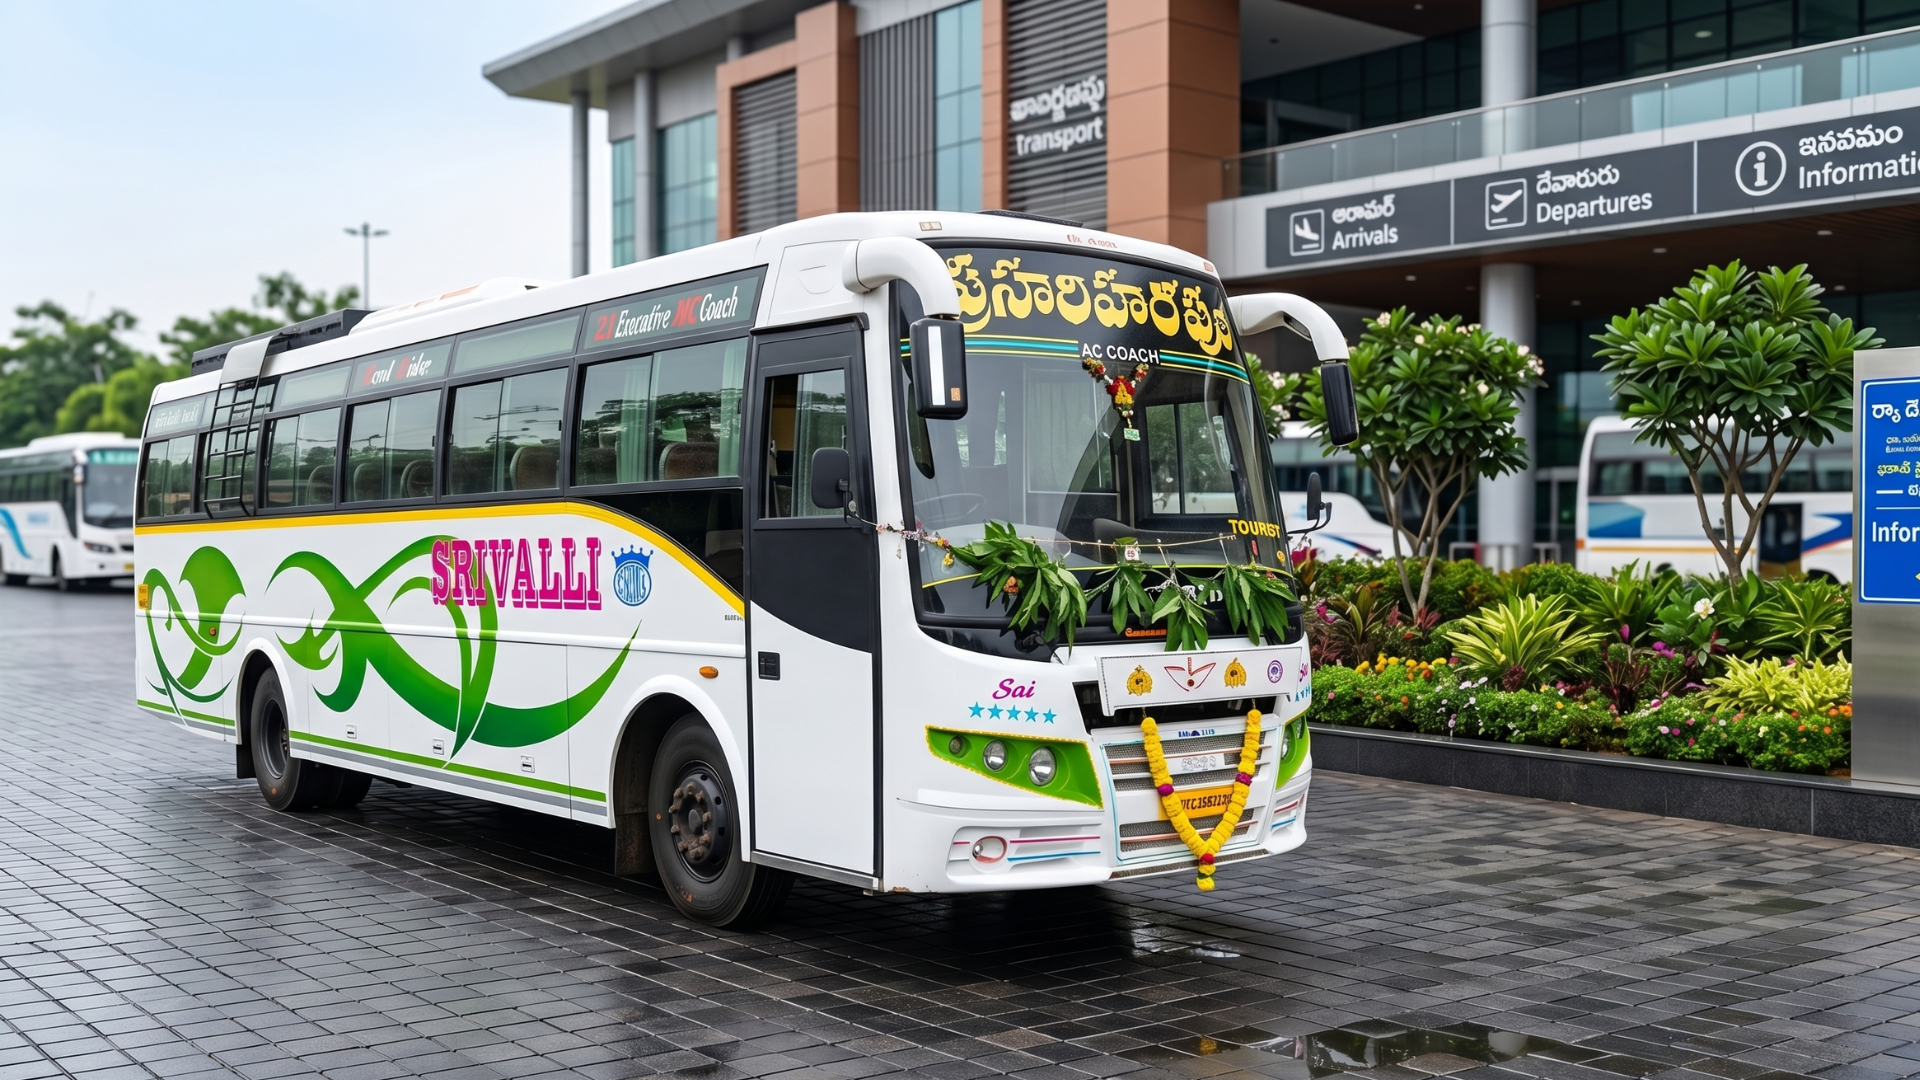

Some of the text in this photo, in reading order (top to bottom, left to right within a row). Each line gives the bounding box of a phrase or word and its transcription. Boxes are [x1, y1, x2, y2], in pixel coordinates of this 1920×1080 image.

[1799, 150, 1920, 189] Informati
[1536, 192, 1653, 225] Departures
[1332, 223, 1398, 250] Arrivals
[593, 311, 617, 341] 21
[700, 286, 738, 322] Coach
[1081, 343, 1160, 364] AC COACH
[431, 537, 602, 611] SRIVALLI
[992, 678, 1036, 700] Sai
